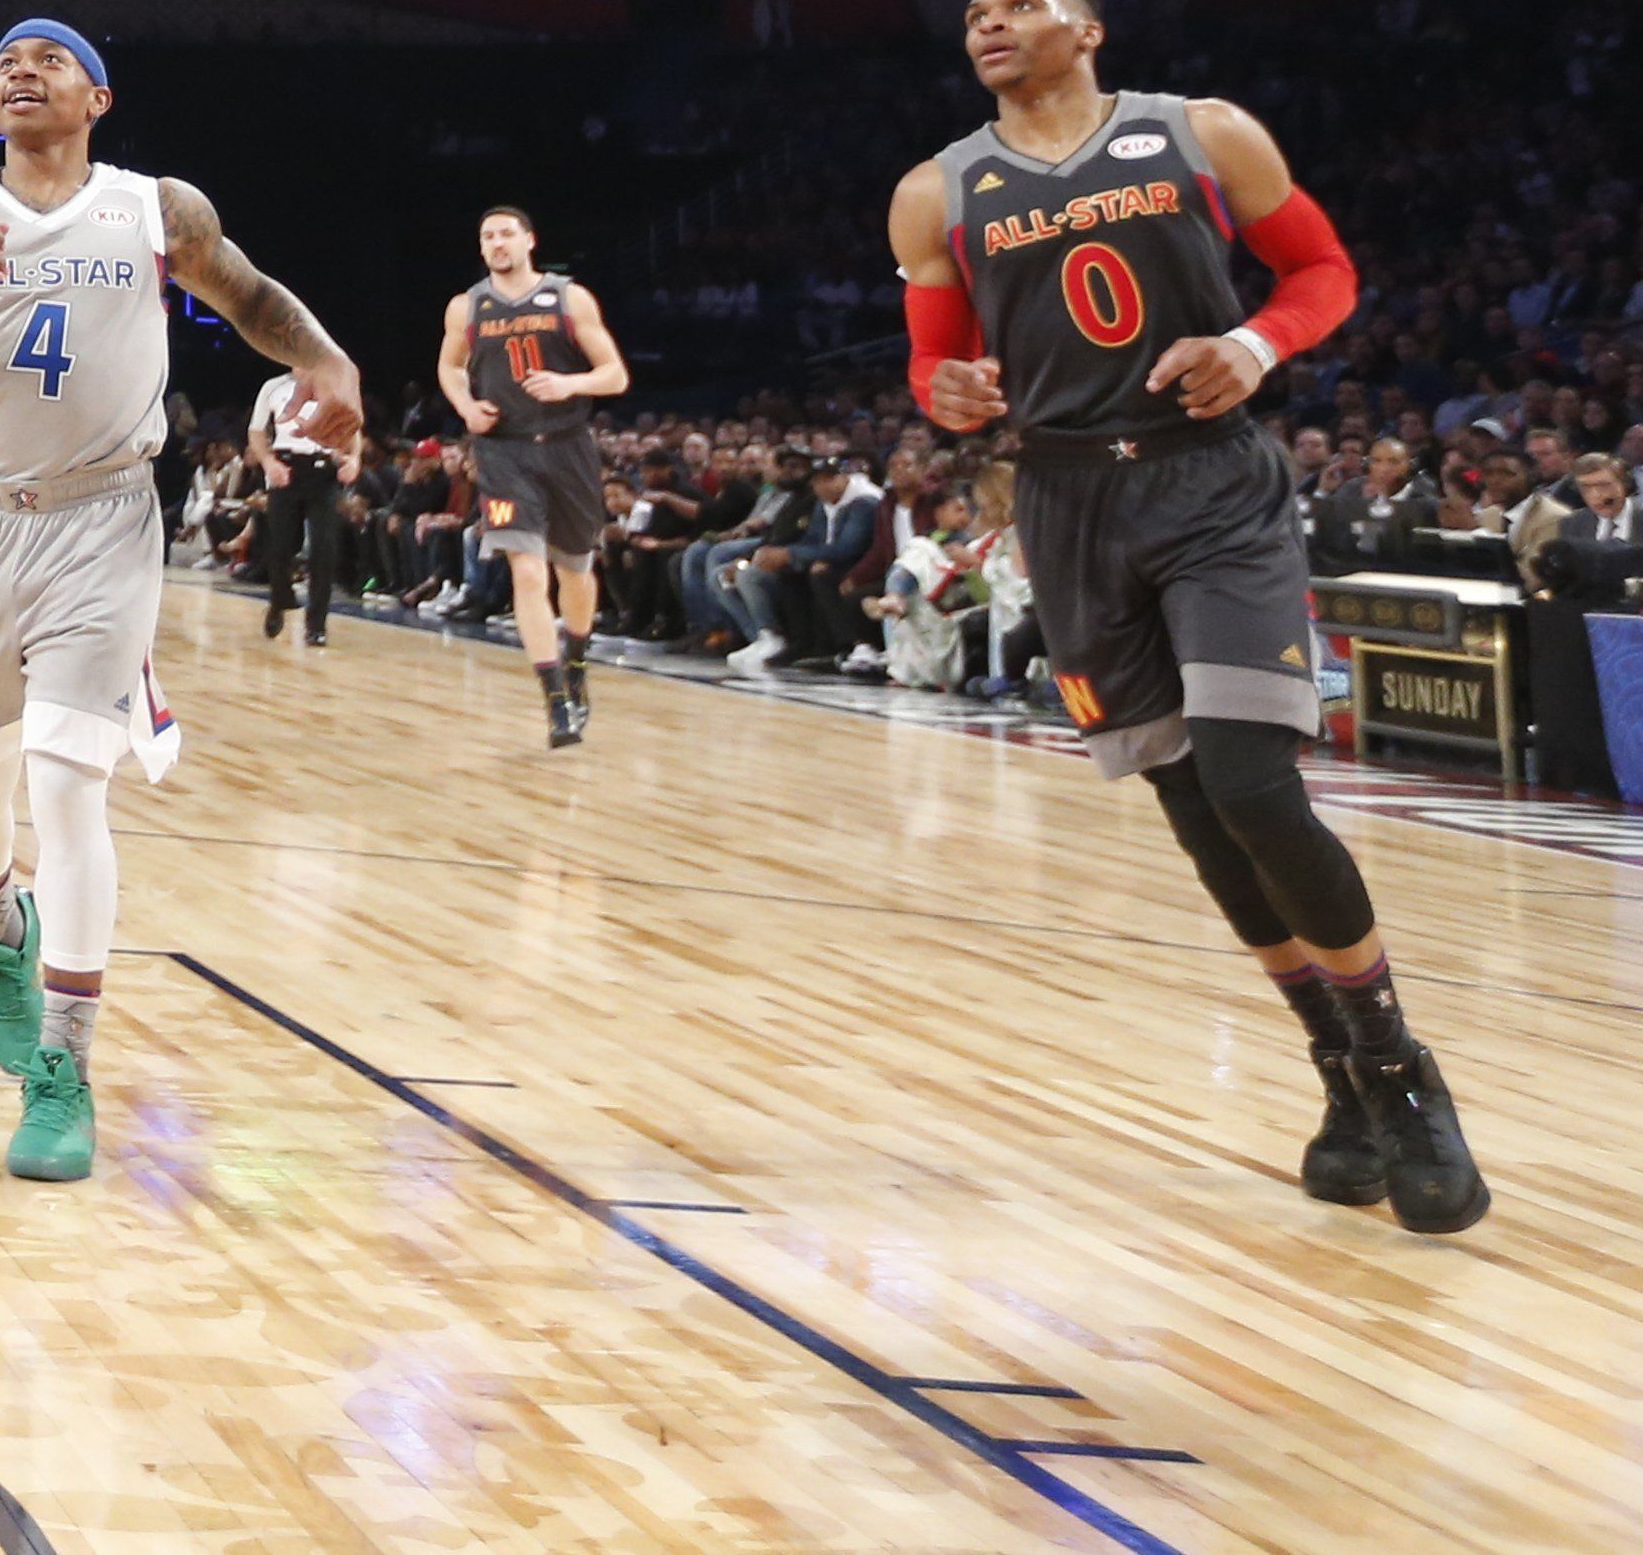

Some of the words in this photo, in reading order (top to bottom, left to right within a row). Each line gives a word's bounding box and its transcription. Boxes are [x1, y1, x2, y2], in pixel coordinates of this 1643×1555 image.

[1061, 241, 1145, 348] 0
[6, 299, 77, 402] 4
[505, 334, 544, 382] 11
[1381, 671, 1482, 719] SUNDAY
